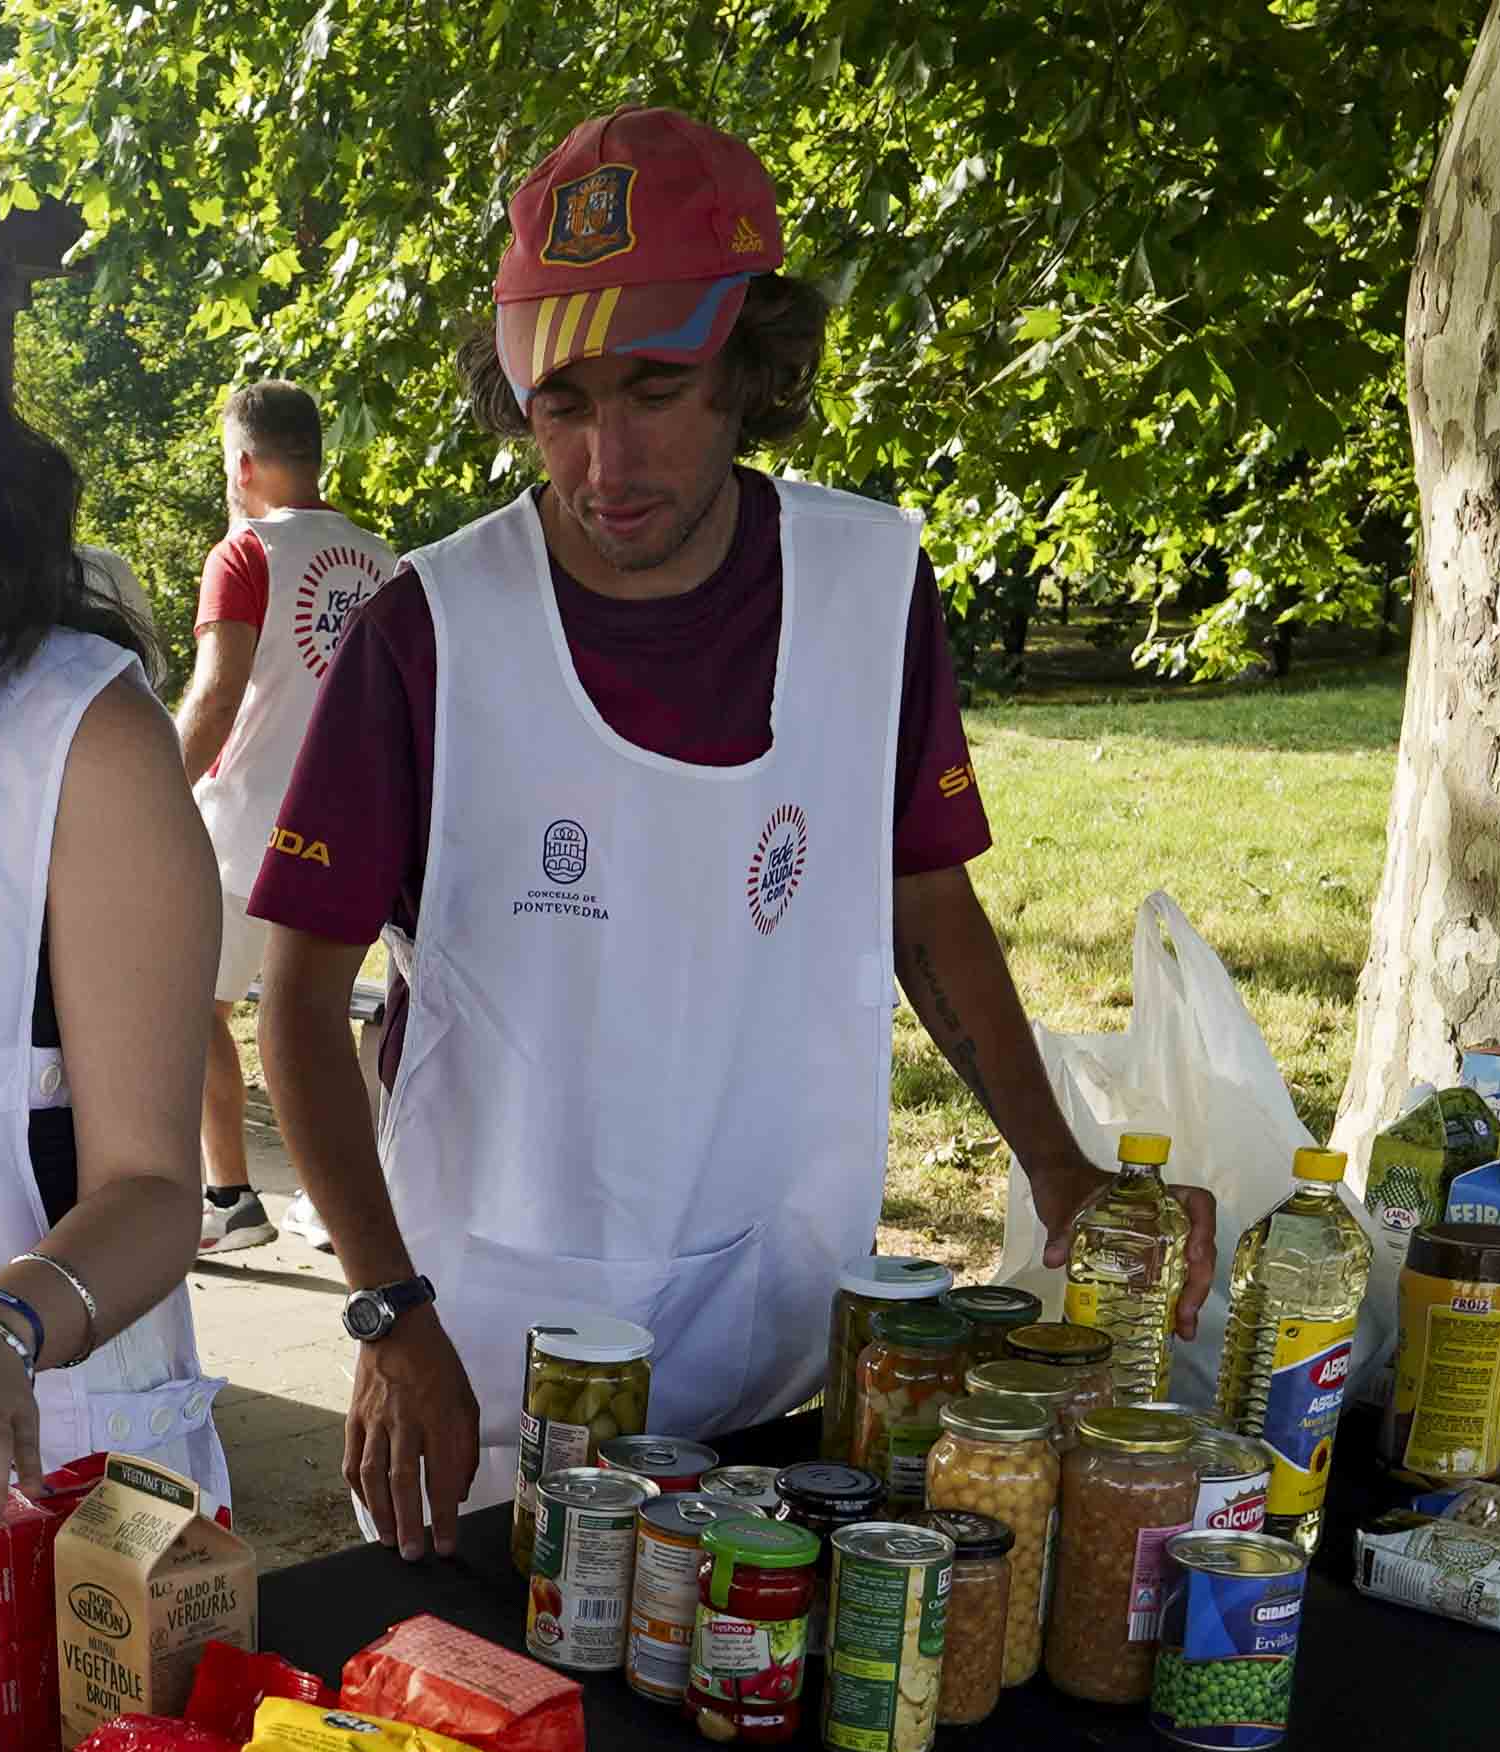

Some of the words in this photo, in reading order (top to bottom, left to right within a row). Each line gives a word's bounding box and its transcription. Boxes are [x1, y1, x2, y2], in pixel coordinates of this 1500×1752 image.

[760, 862, 794, 892] AXUDA
[513, 901, 609, 920] PONTEVEDRA
[528, 890, 579, 900] CONCELLO
[583, 895, 601, 903] DE
[1452, 1298, 1489, 1311] FROIZ
[88, 1591, 114, 1610] DON
[176, 1581, 211, 1604] CALDO
[214, 1575, 227, 1591] DE
[167, 1589, 237, 1631] VERDURAS
[63, 1639, 144, 1702] VEGETABLE
[87, 1681, 121, 1715] BROTH
